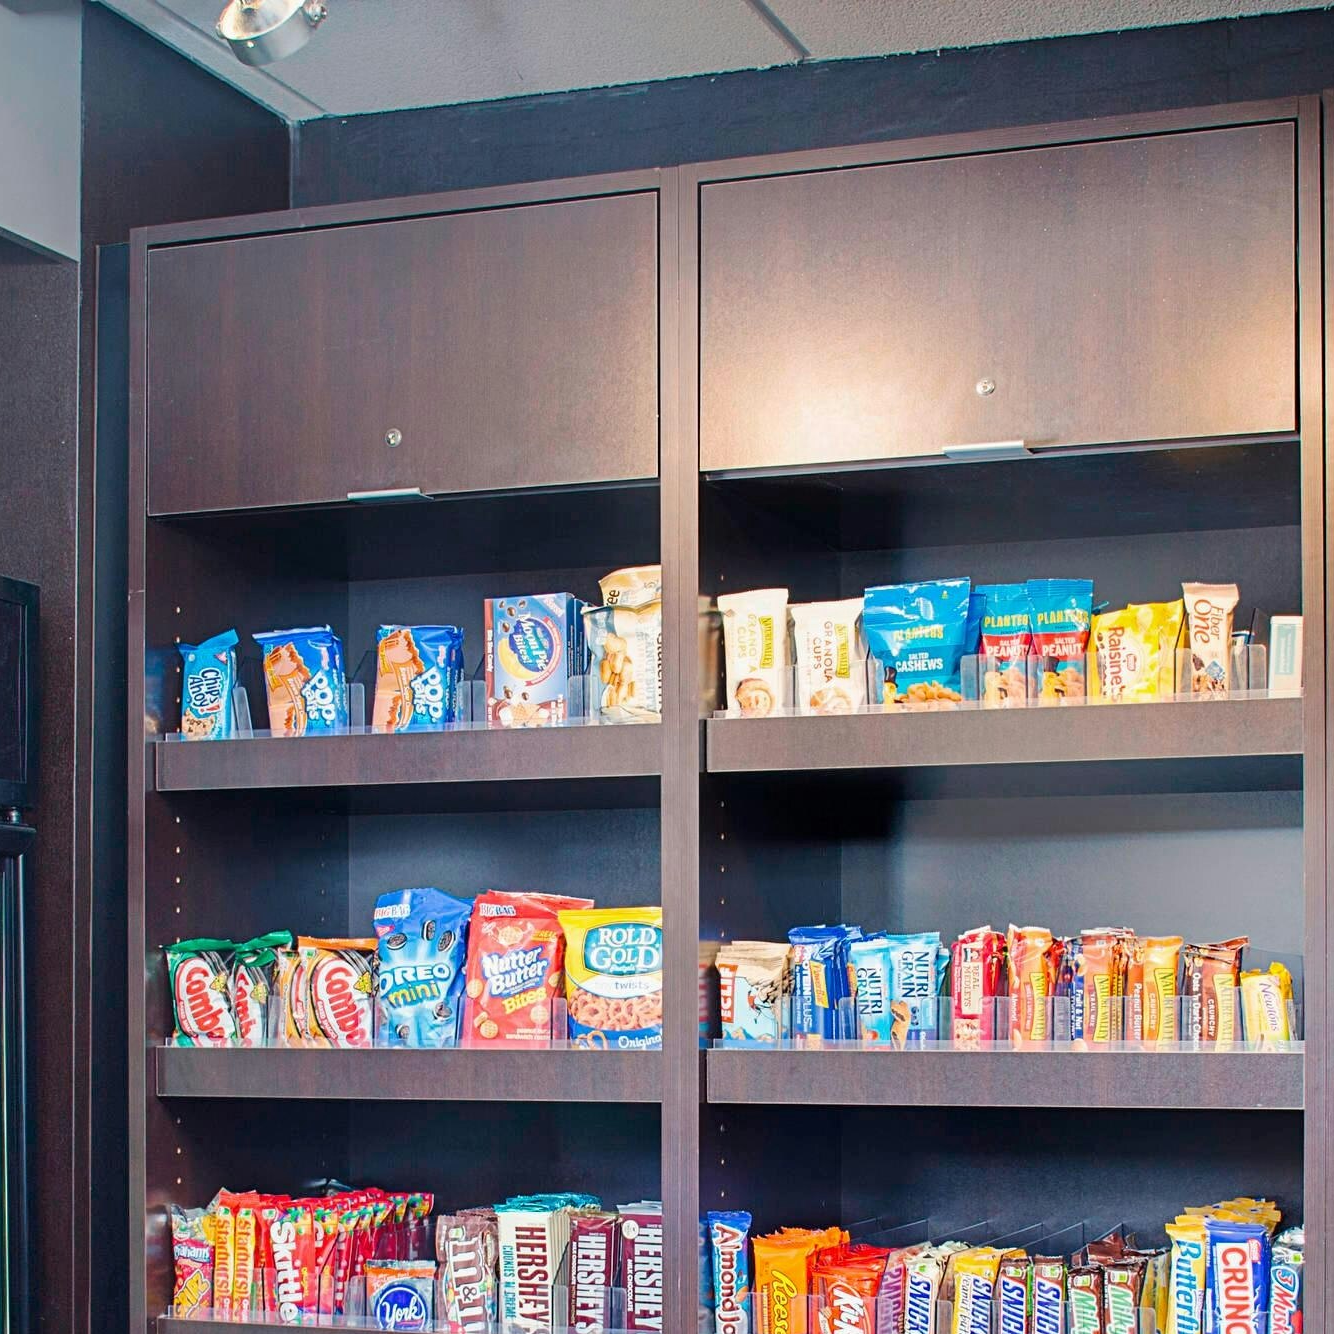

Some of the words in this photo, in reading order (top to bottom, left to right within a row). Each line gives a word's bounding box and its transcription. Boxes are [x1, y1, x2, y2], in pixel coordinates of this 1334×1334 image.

[1194, 599, 1212, 644] One
[1210, 606, 1226, 641] Fiber
[895, 660, 944, 673] CASHEWS
[200, 668, 223, 704] Chips
[598, 926, 658, 946] ROLD
[482, 947, 542, 977] Nutter
[589, 945, 661, 970] GOLD
[902, 951, 916, 998] GRAIN
[914, 951, 930, 997] NUTRI
[379, 963, 451, 996] OREO
[388, 982, 440, 1007] mini
[490, 960, 549, 995] Butter
[857, 968, 868, 1015] GRAIN
[867, 968, 883, 1014] NUTRI
[502, 988, 548, 1014] Bites
[1208, 998, 1216, 1037] CRUNCHY
[503, 1245, 515, 1278] COOKIES
[714, 1223, 743, 1314] Almond
[382, 1297, 424, 1329] York
[504, 1290, 517, 1319] CREME
